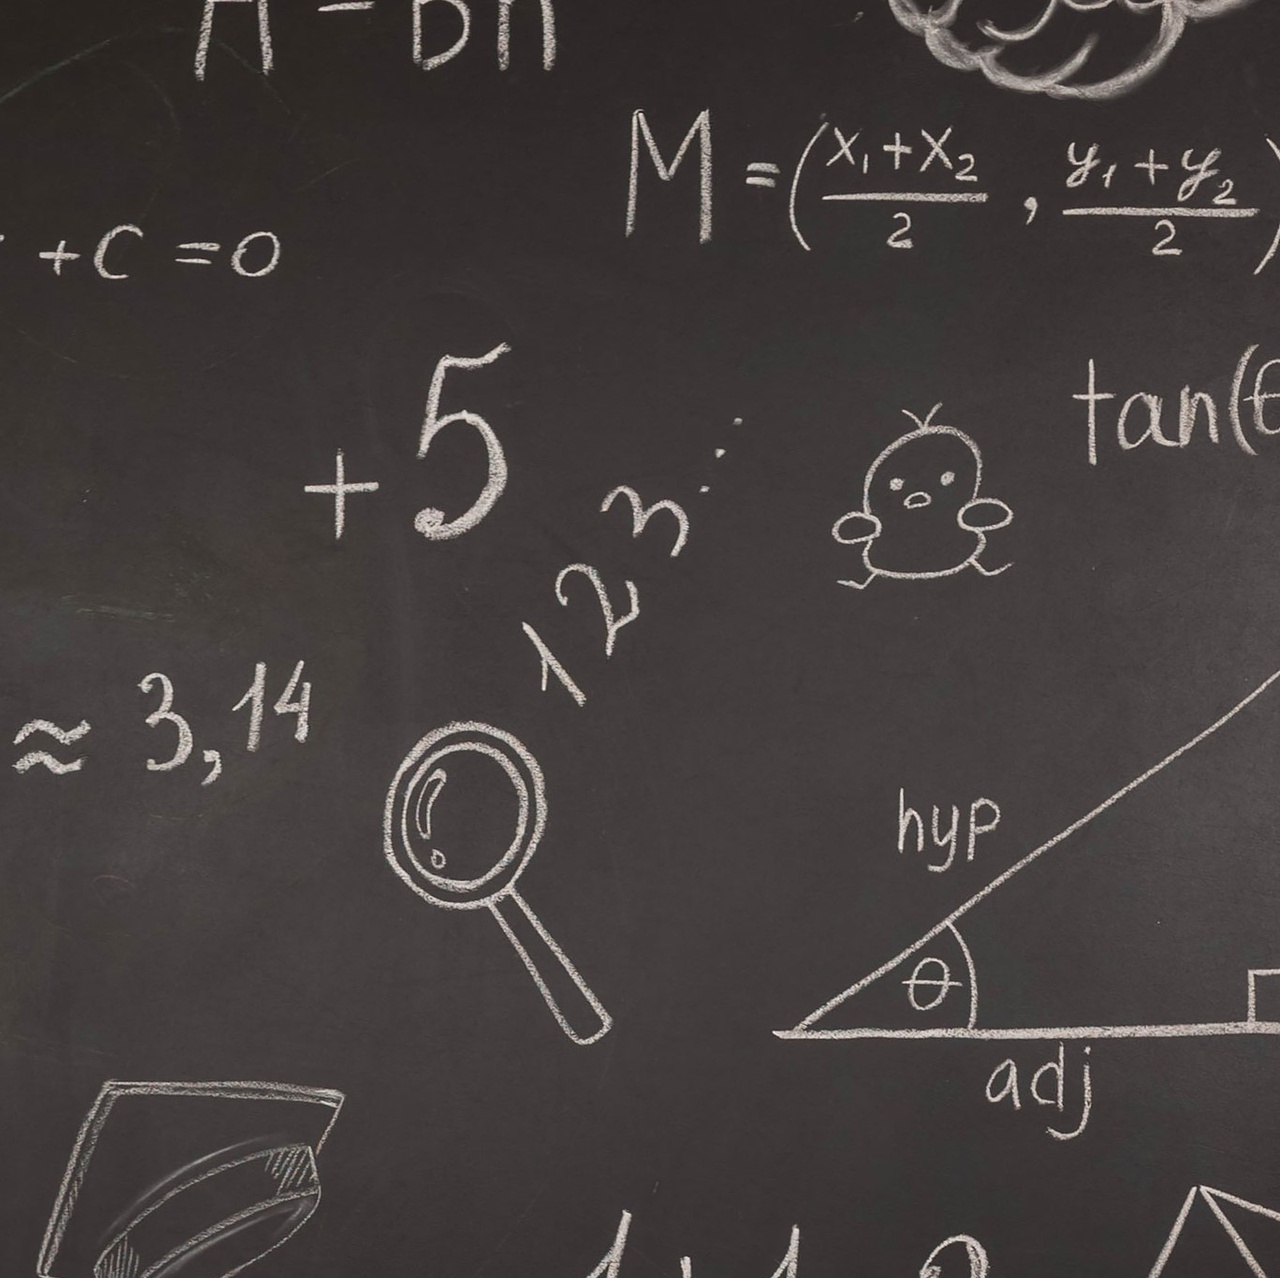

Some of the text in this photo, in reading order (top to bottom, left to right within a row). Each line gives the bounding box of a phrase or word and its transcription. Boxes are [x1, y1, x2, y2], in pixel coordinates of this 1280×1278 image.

[886, 211, 914, 249] 2
[1151, 219, 1183, 256] 2
[897, 787, 1001, 873] hyp
[985, 1042, 1093, 1141] adj
